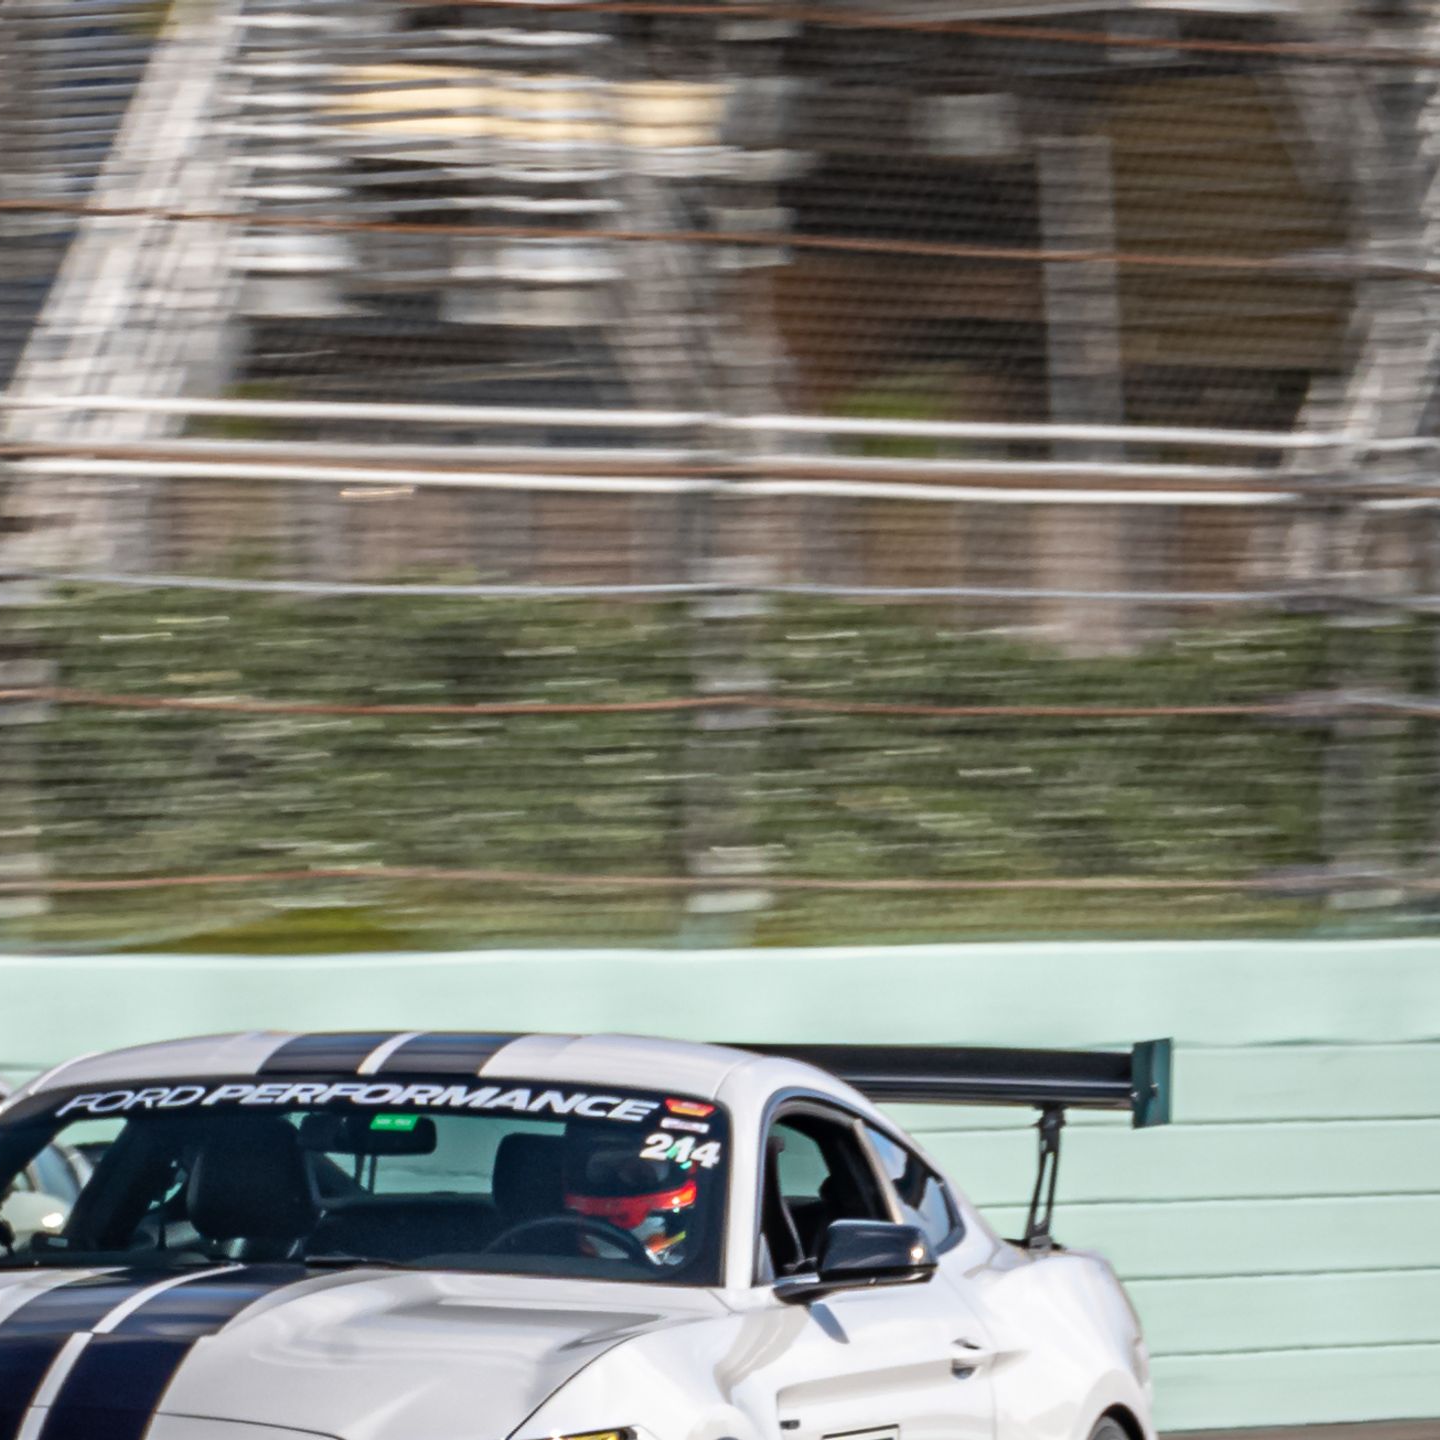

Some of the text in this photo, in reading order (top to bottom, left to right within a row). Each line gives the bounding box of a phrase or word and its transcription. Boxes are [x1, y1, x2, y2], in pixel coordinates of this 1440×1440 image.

[57, 1086, 204, 1116] FORD
[201, 1083, 661, 1122] PERFORMANCE
[639, 1132, 721, 1169] 214
